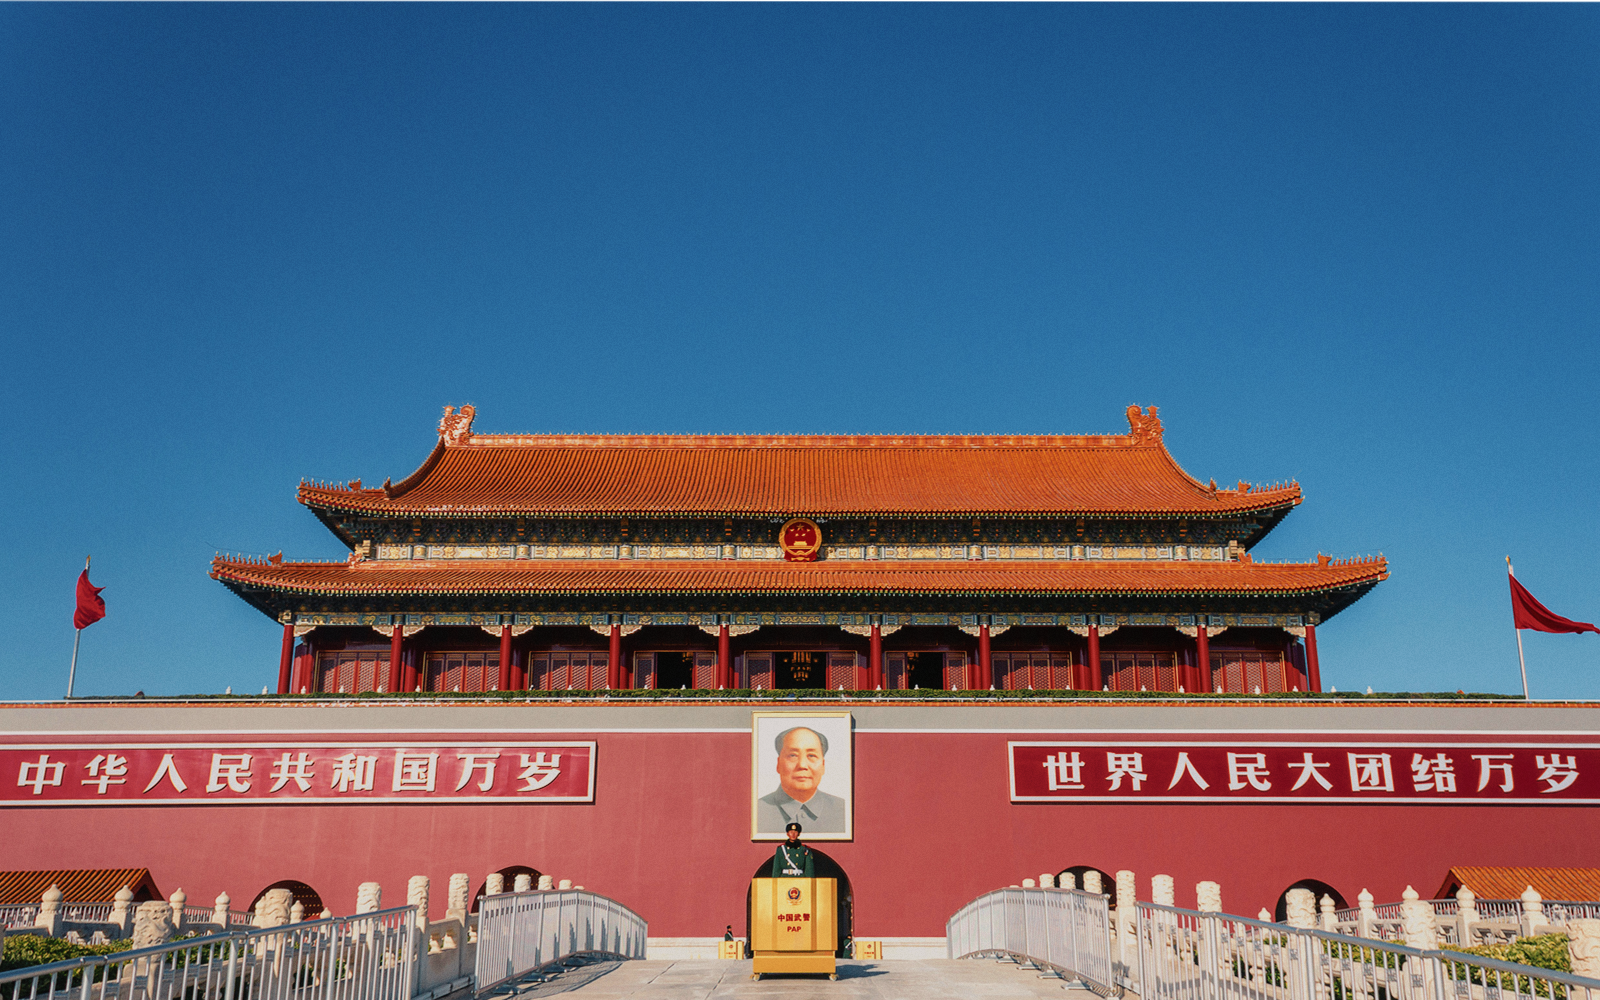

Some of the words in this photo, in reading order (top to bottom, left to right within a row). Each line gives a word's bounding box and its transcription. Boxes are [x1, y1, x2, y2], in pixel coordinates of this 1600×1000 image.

[16, 752, 563, 795] 中华人民共和国万岁
[1042, 751, 1580, 793] 世界人民大团结万岁
[777, 913, 811, 922] 中国武警
[786, 925, 802, 933] PAP
